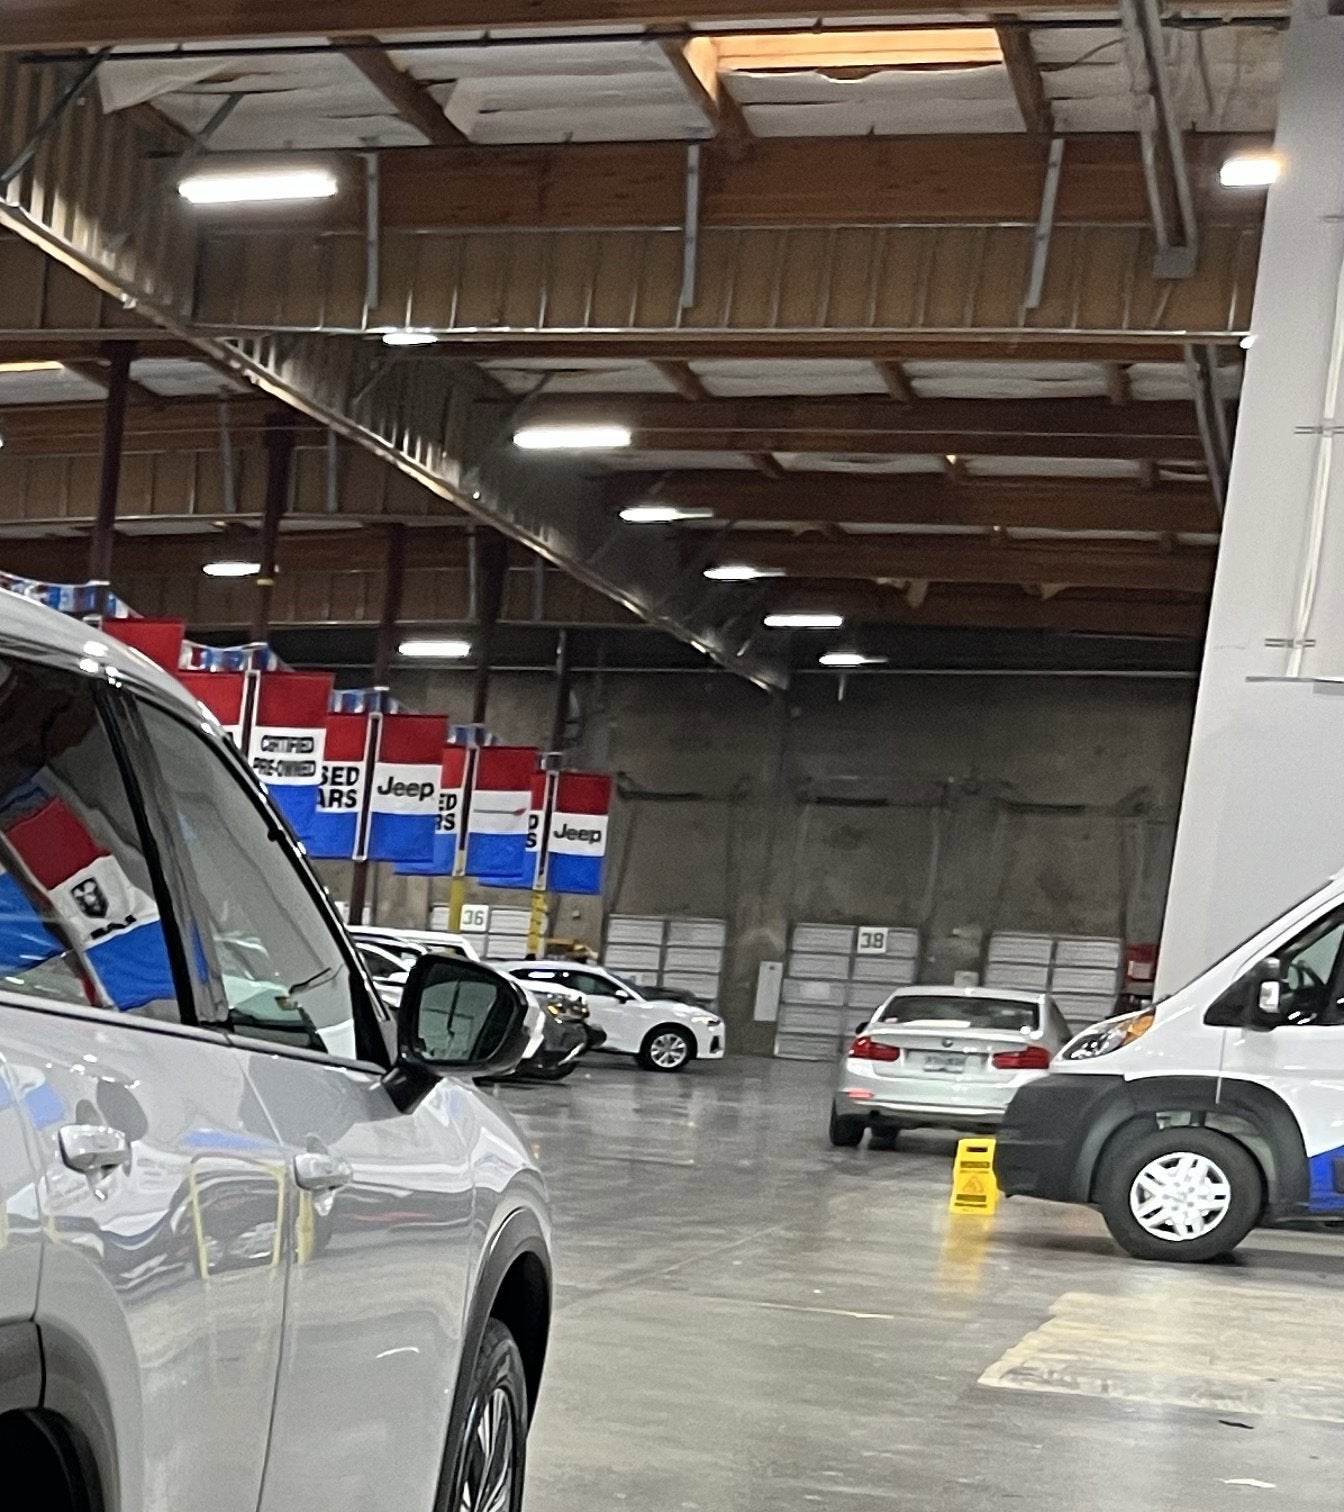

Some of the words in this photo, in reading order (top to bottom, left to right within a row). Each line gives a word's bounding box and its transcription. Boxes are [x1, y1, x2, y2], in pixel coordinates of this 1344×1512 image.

[319, 766, 360, 786] SED
[377, 777, 434, 801] Jeep
[554, 824, 602, 844] Jeep
[462, 910, 484, 925] 36
[861, 932, 884, 949] 38
